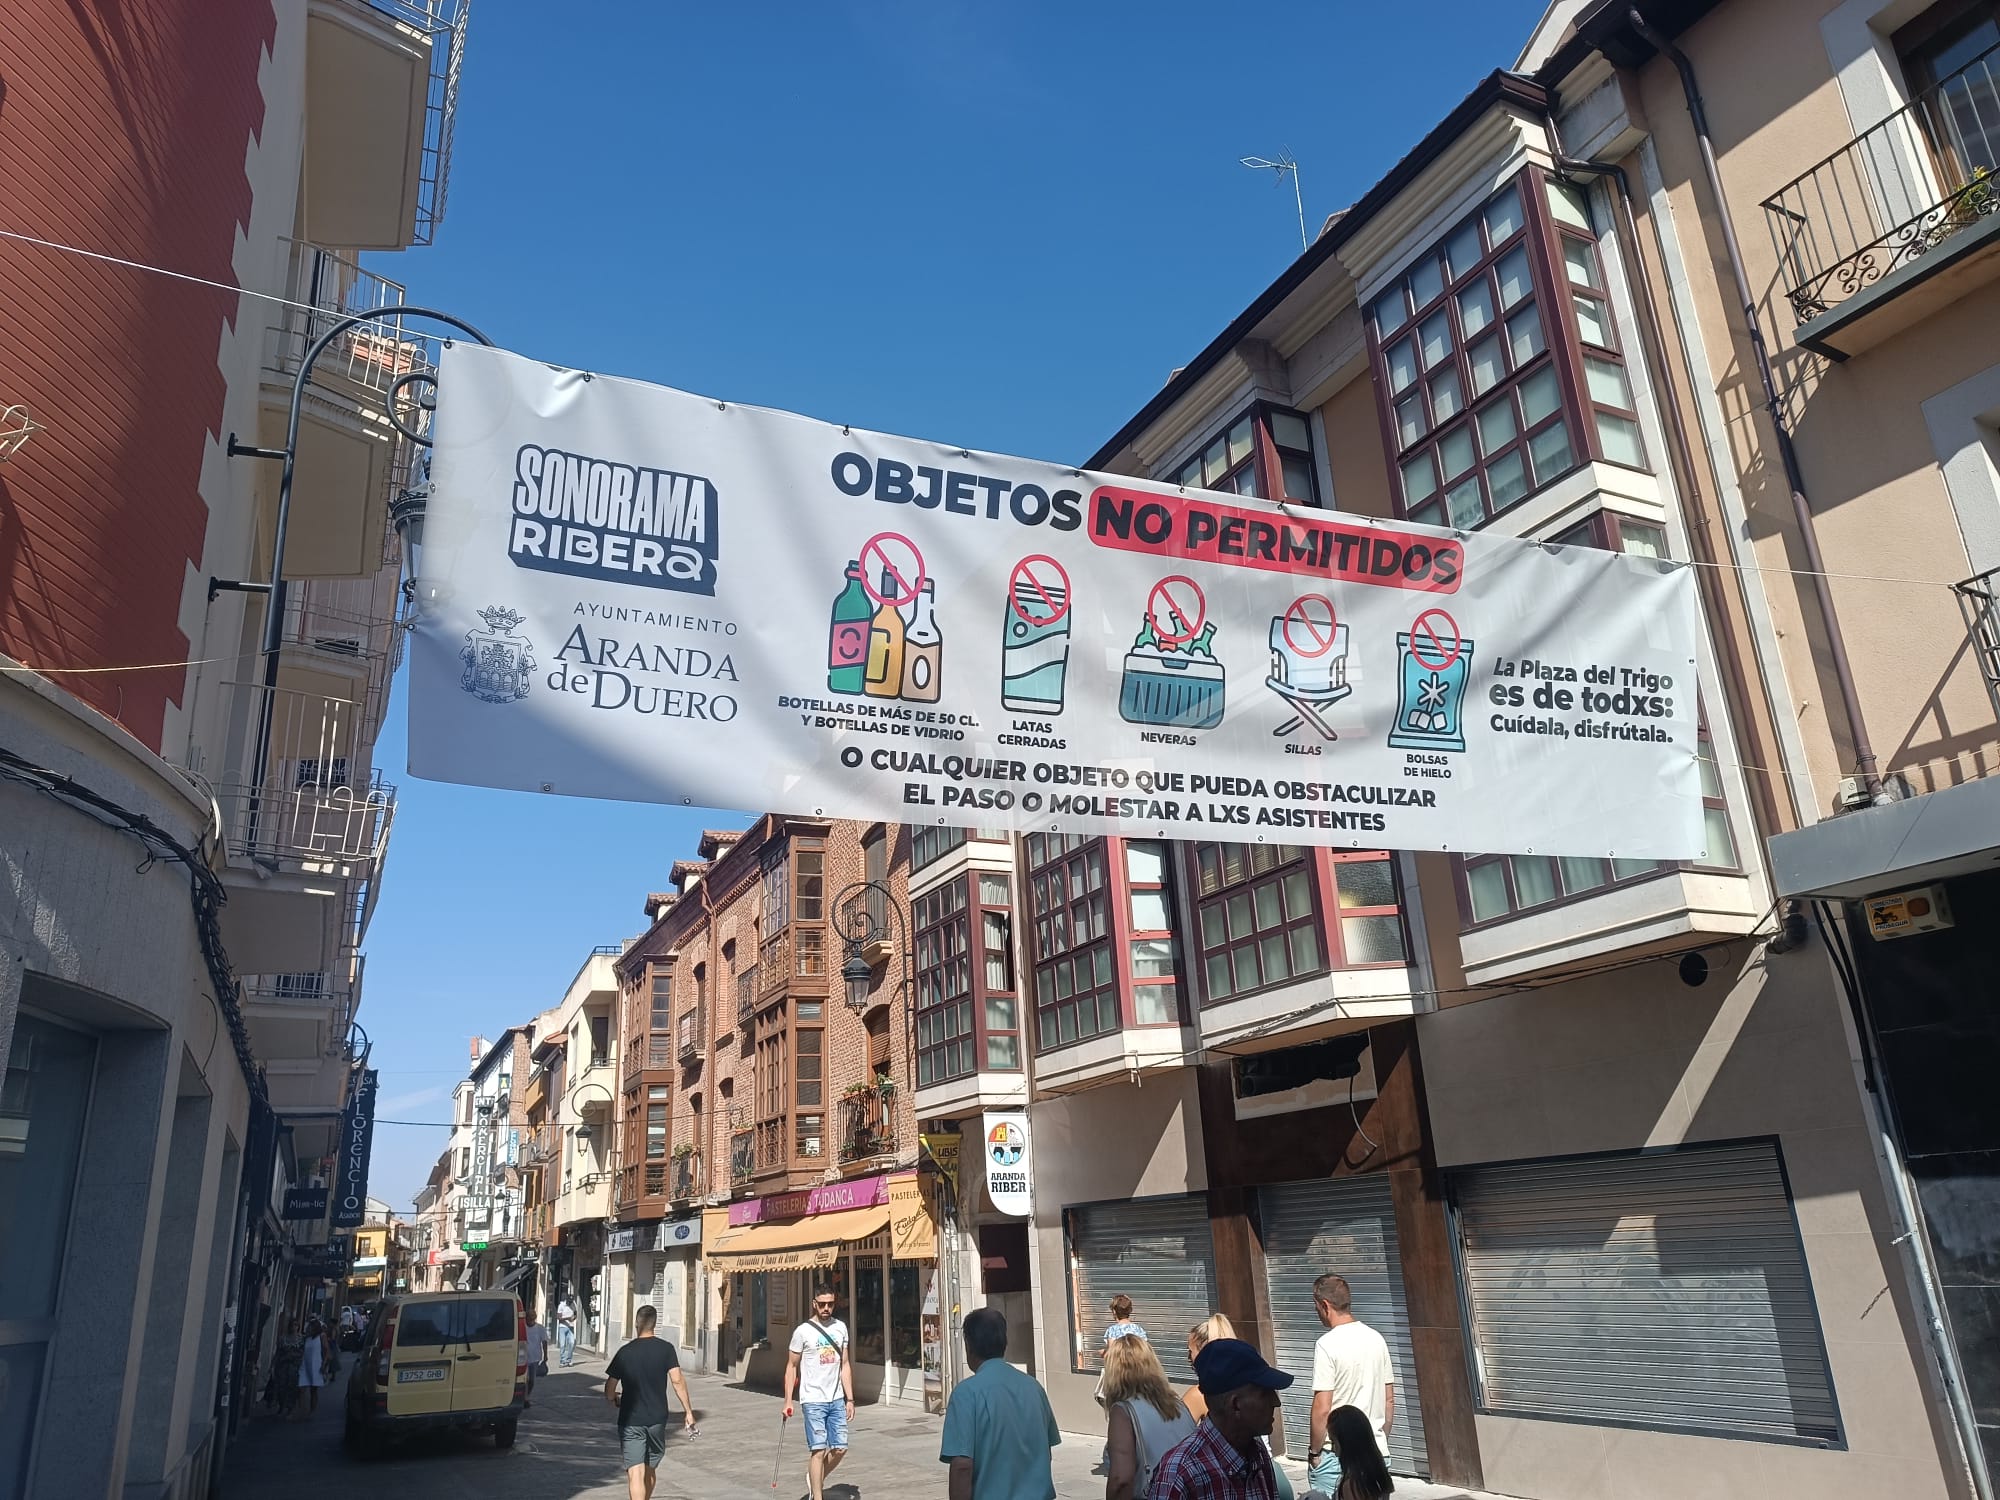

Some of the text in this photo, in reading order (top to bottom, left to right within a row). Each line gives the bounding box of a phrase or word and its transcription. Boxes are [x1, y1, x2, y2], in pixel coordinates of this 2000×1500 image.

[515, 447, 706, 544] SONORAMA
[830, 451, 1458, 585] OBJETOS NO PERMITIDOS
[573, 601, 738, 636] AYUNTAMIENTO
[553, 623, 740, 682] ARANDA
[1493, 657, 1674, 693] La Plaza del Trigo
[546, 663, 738, 722] de DUERO
[1489, 681, 1674, 719] es de todxs:
[778, 695, 980, 727] BOTELLAS DE MÁS DE 50 CL.
[801, 714, 965, 742] Y BOTELLAS DE VIDRIO
[997, 733, 1067, 750] CERRADAS
[1012, 719, 1053, 734] LATAS
[1141, 731, 1198, 746] NEVERAS
[1490, 714, 1674, 743] Cuídala, disfrútala.
[1284, 743, 1322, 756] SILLAS
[1406, 753, 1449, 766] BOLSAS
[840, 746, 1437, 808] O CUALQUIER OBJETO QUE PUEDA OBSTACULIZAR
[1403, 765, 1452, 779] DE HIELO
[903, 782, 1387, 832] EL PASO O MOLESTAR A LXS ASISTENTES
[343, 1087, 369, 1210] FLORENCIO
[990, 1172, 1027, 1181] ARANDA
[990, 1181, 1027, 1193] RIBER
[460, 1195, 491, 1209] ISILLA
[766, 1197, 812, 1217] PASTELERIAS
[814, 1187, 854, 1208] TUDANCA
